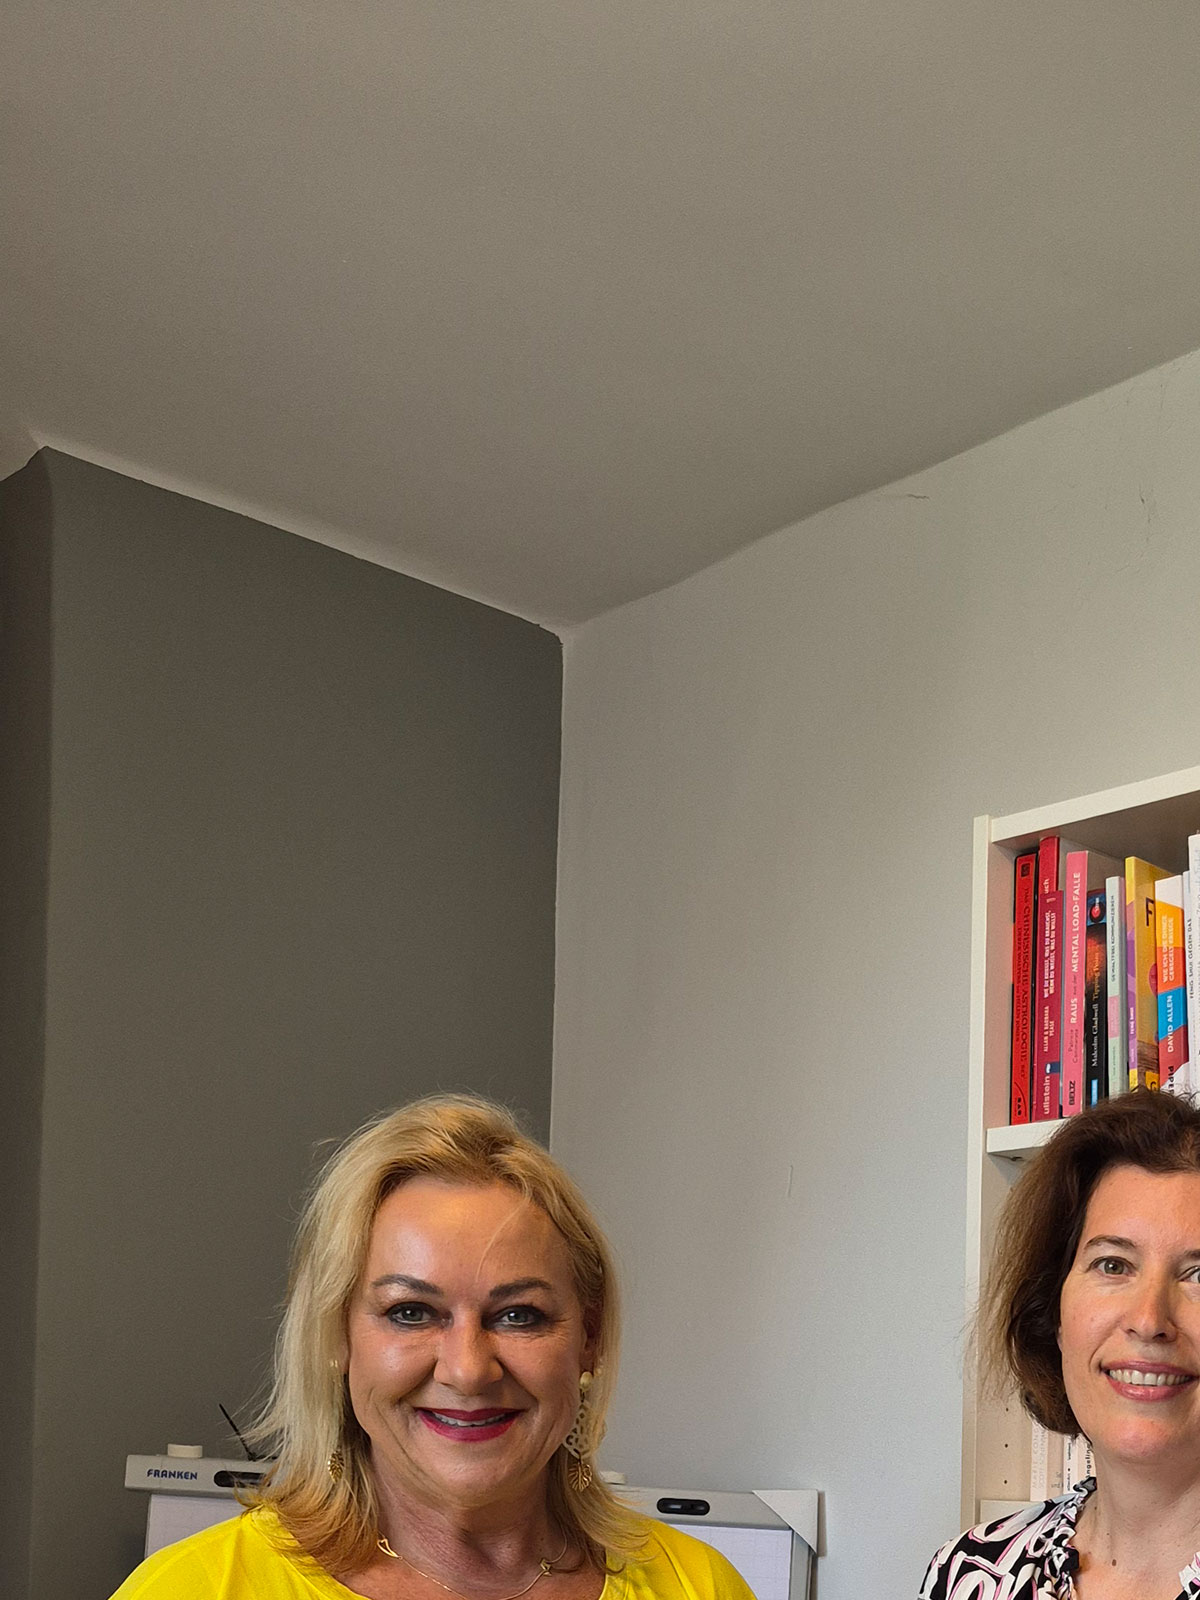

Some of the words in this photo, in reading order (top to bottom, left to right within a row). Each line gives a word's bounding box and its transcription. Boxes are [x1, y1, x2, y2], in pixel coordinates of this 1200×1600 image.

[1072, 933, 1080, 972] MENTAL
[1093, 973, 1101, 1000] Tipping
[1070, 998, 1078, 1024] RAUS
[1166, 995, 1174, 1023] ALLEN
[146, 1469, 198, 1480] FRANKEN
